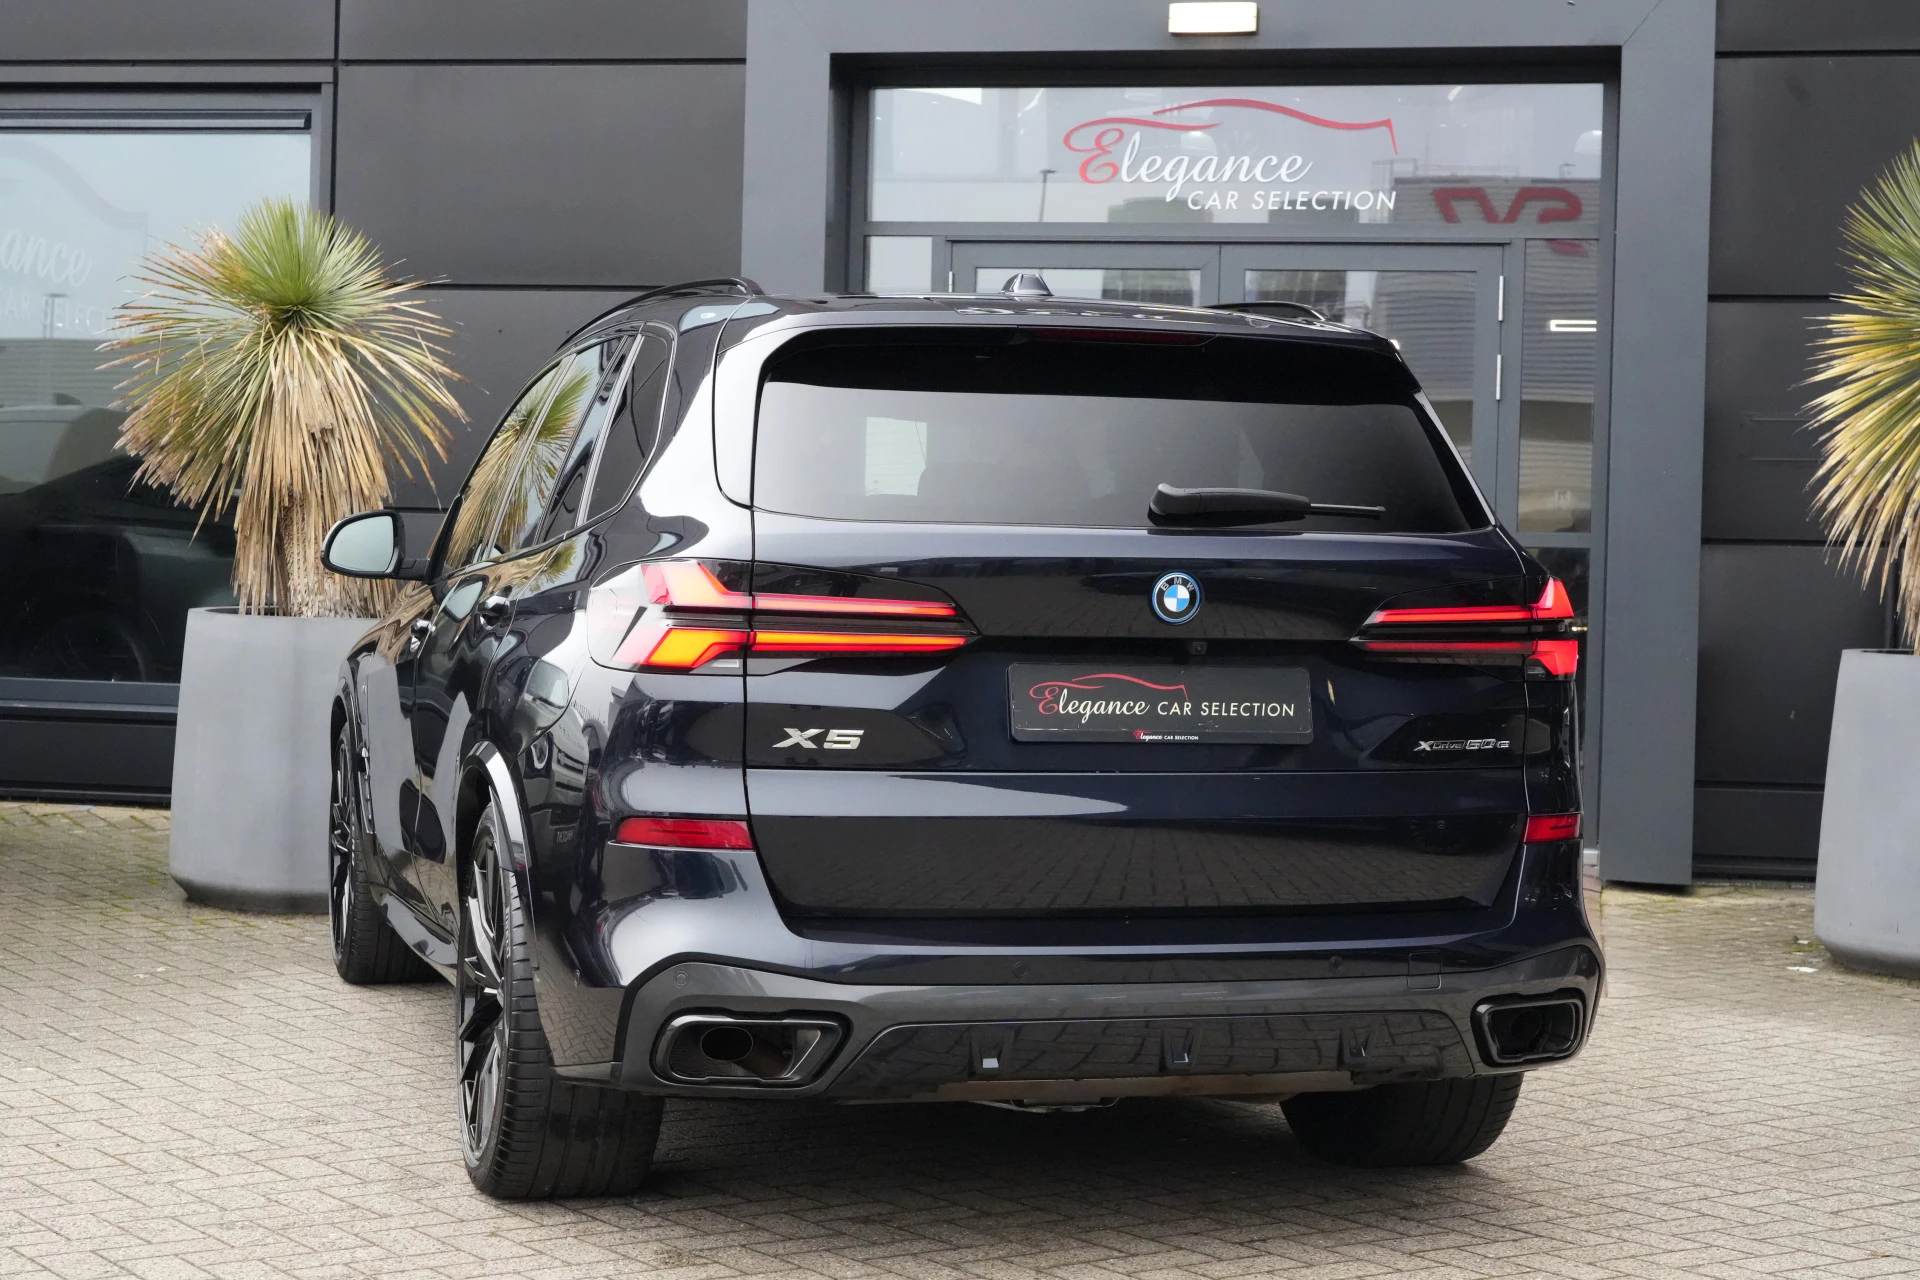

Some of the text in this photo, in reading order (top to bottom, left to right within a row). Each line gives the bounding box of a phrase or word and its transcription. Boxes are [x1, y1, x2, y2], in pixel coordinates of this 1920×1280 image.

[1063, 118, 1314, 203] Elegance
[1187, 190, 1396, 211] CAR SELECTION
[1160, 576, 1195, 592] BMW
[1029, 681, 1295, 724] Elegance CAR SELECTION
[771, 727, 864, 750] X5
[1133, 730, 1163, 742] Elegance
